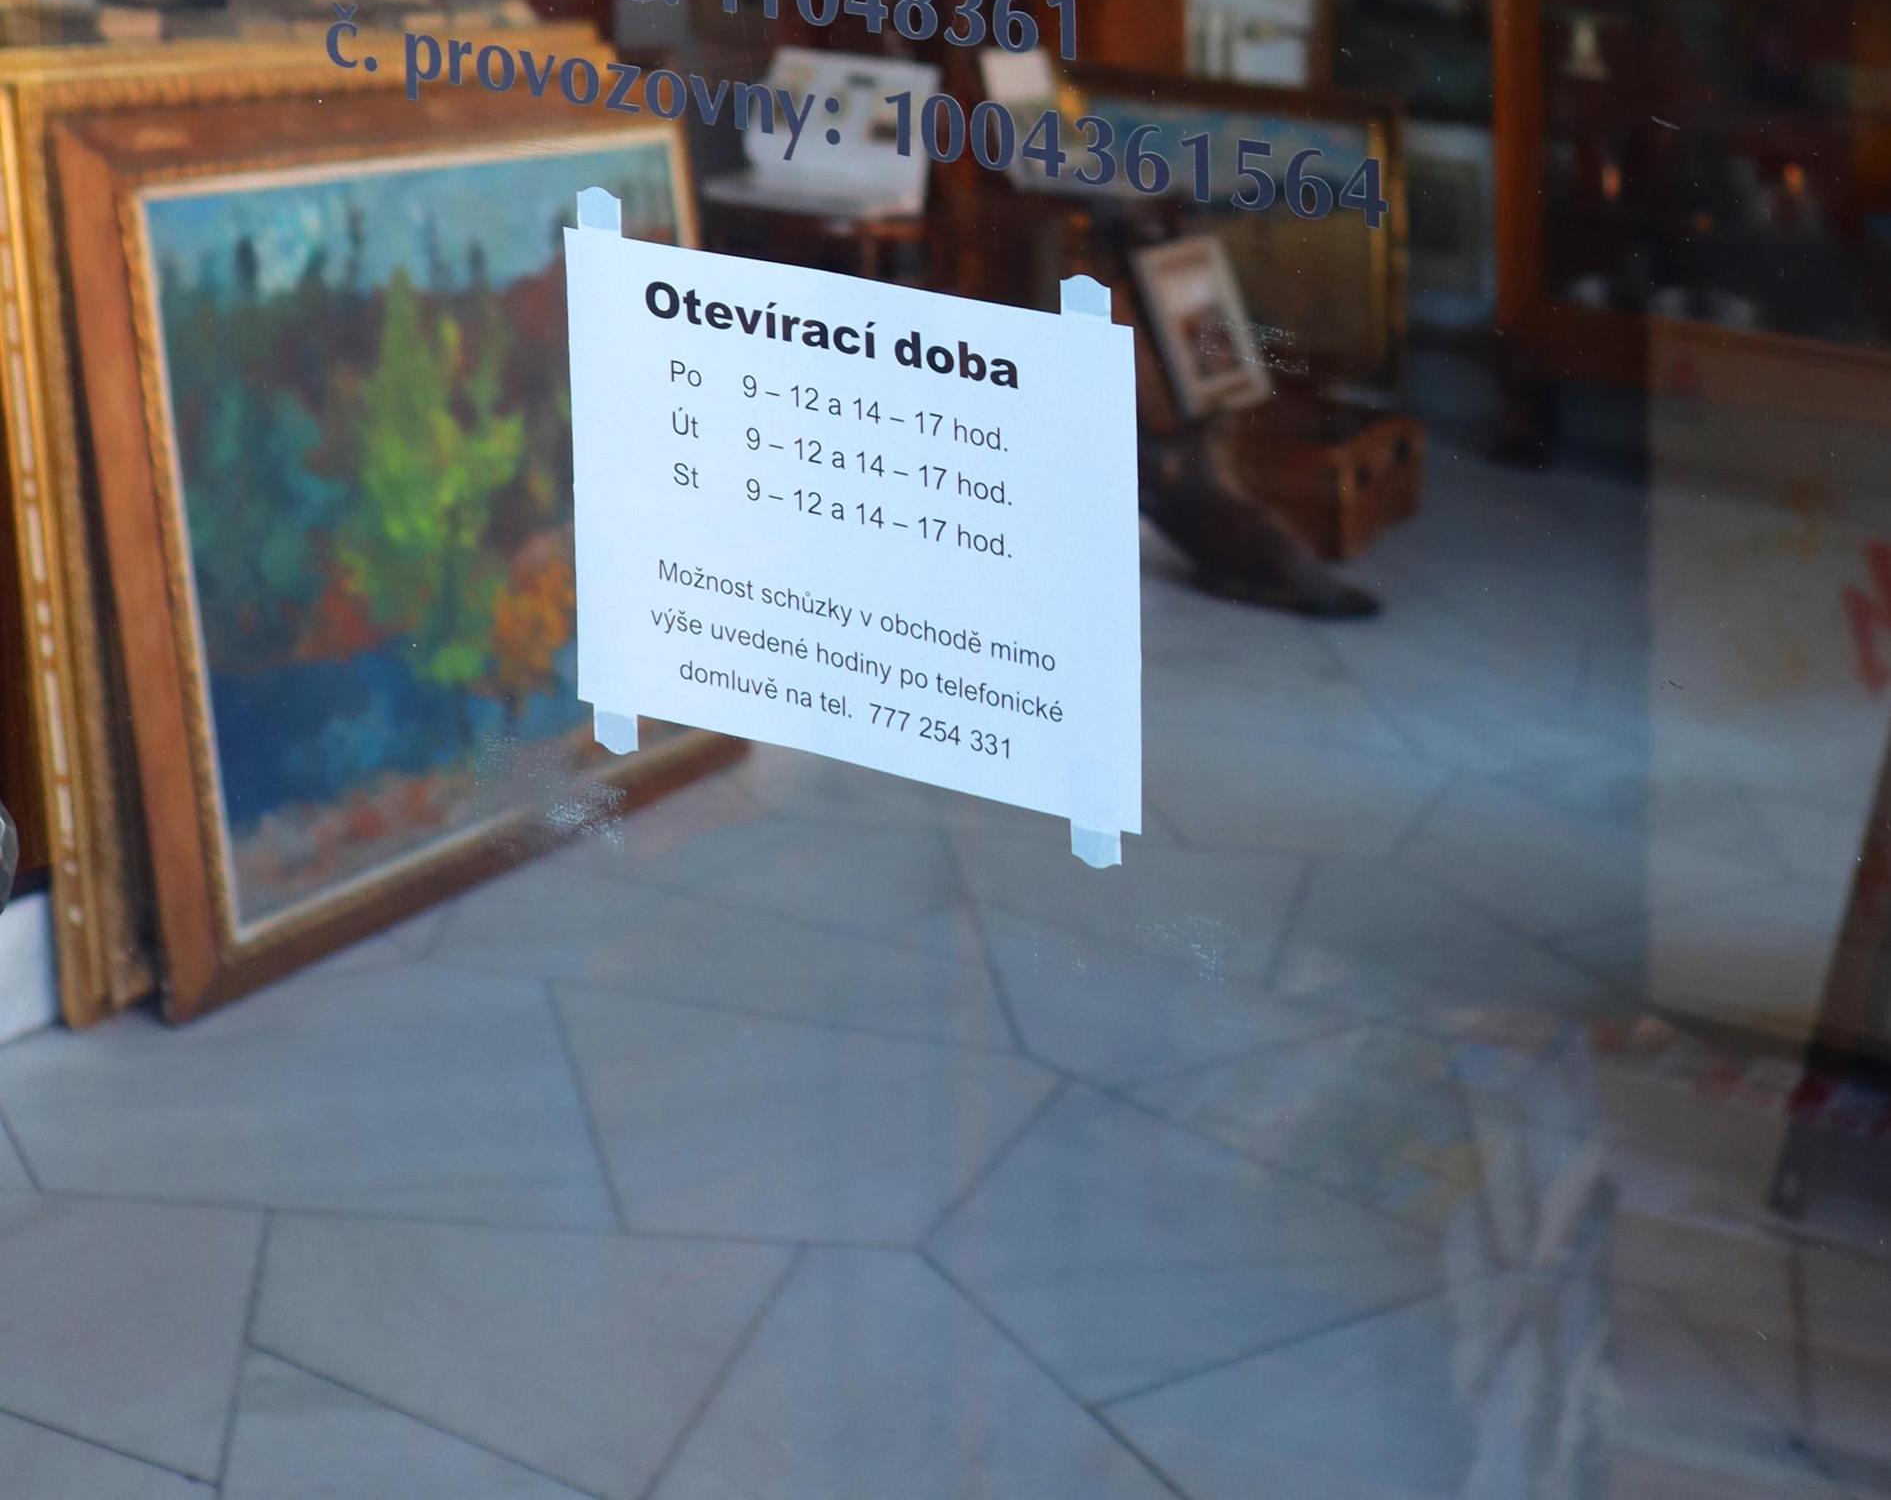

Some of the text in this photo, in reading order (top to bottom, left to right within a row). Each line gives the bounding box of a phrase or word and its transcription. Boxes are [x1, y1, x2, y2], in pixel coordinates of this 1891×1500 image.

[325, 2, 1390, 230] č. provozovny: 1004361564
[644, 280, 1020, 390] Otevírací doba
[670, 359, 703, 388] Po
[742, 374, 758, 399] 9
[790, 384, 820, 412] 12
[827, 397, 842, 417] a
[852, 397, 882, 425] 14
[914, 410, 944, 437] 17
[953, 417, 1009, 453] hod.
[671, 406, 700, 440] Út
[745, 426, 761, 452] 9
[793, 437, 823, 465] 12
[831, 450, 846, 470] a
[855, 450, 886, 478] 14
[918, 463, 948, 491] 17
[957, 470, 1013, 507] hod.
[672, 462, 700, 490] St
[745, 477, 761, 502] 9
[793, 488, 823, 517] 12
[830, 502, 845, 522] a
[855, 502, 885, 530] 14
[917, 515, 948, 543] 17
[957, 523, 1013, 559] hod.
[650, 607, 1064, 723] výše uvedené hodiny po telefonické
[658, 558, 1056, 672] Možnost schůzky v obchodě mimo
[679, 659, 1010, 760] domluvě na tel. 777 254 331
